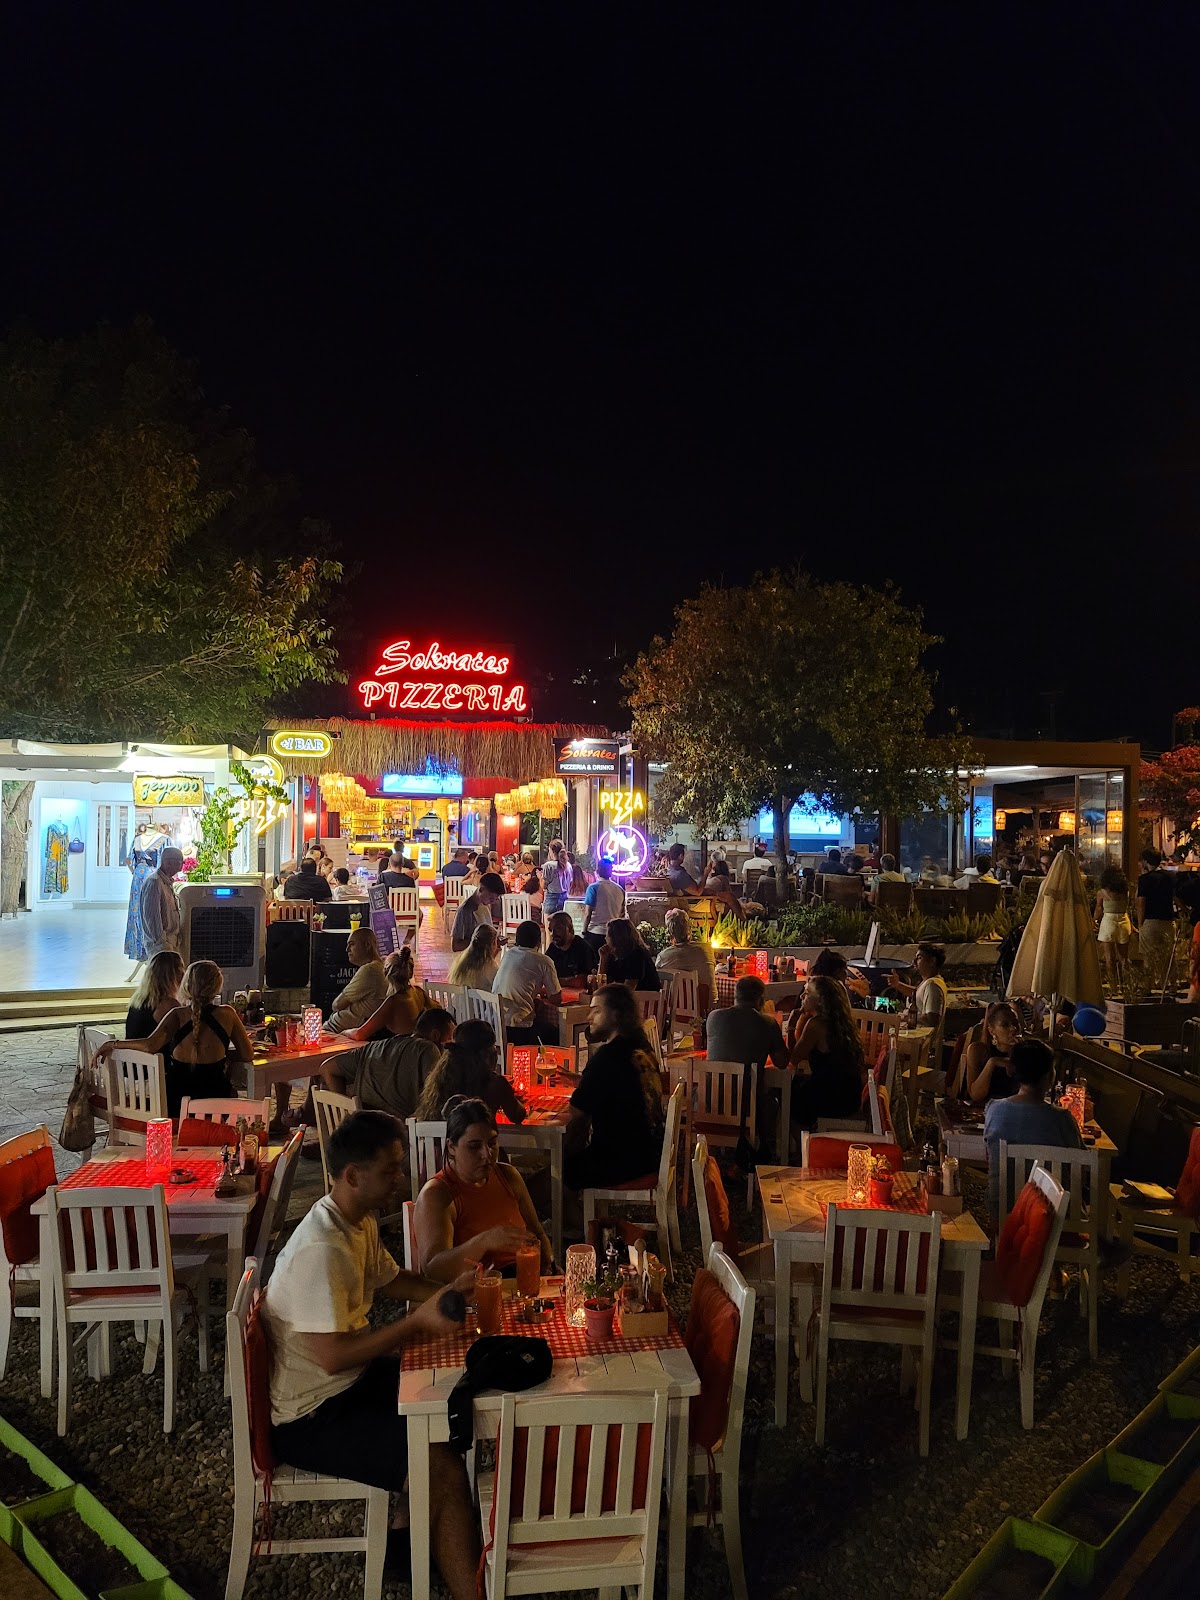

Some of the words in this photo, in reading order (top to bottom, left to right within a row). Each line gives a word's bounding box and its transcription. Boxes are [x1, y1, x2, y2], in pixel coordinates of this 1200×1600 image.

[375, 641, 509, 676] Sokrates
[359, 681, 526, 711] PIZZERIA
[295, 738, 324, 750] BAR
[558, 744, 617, 761] Sokrates
[241, 799, 288, 832] PIZZA
[600, 791, 644, 824] PIZZA
